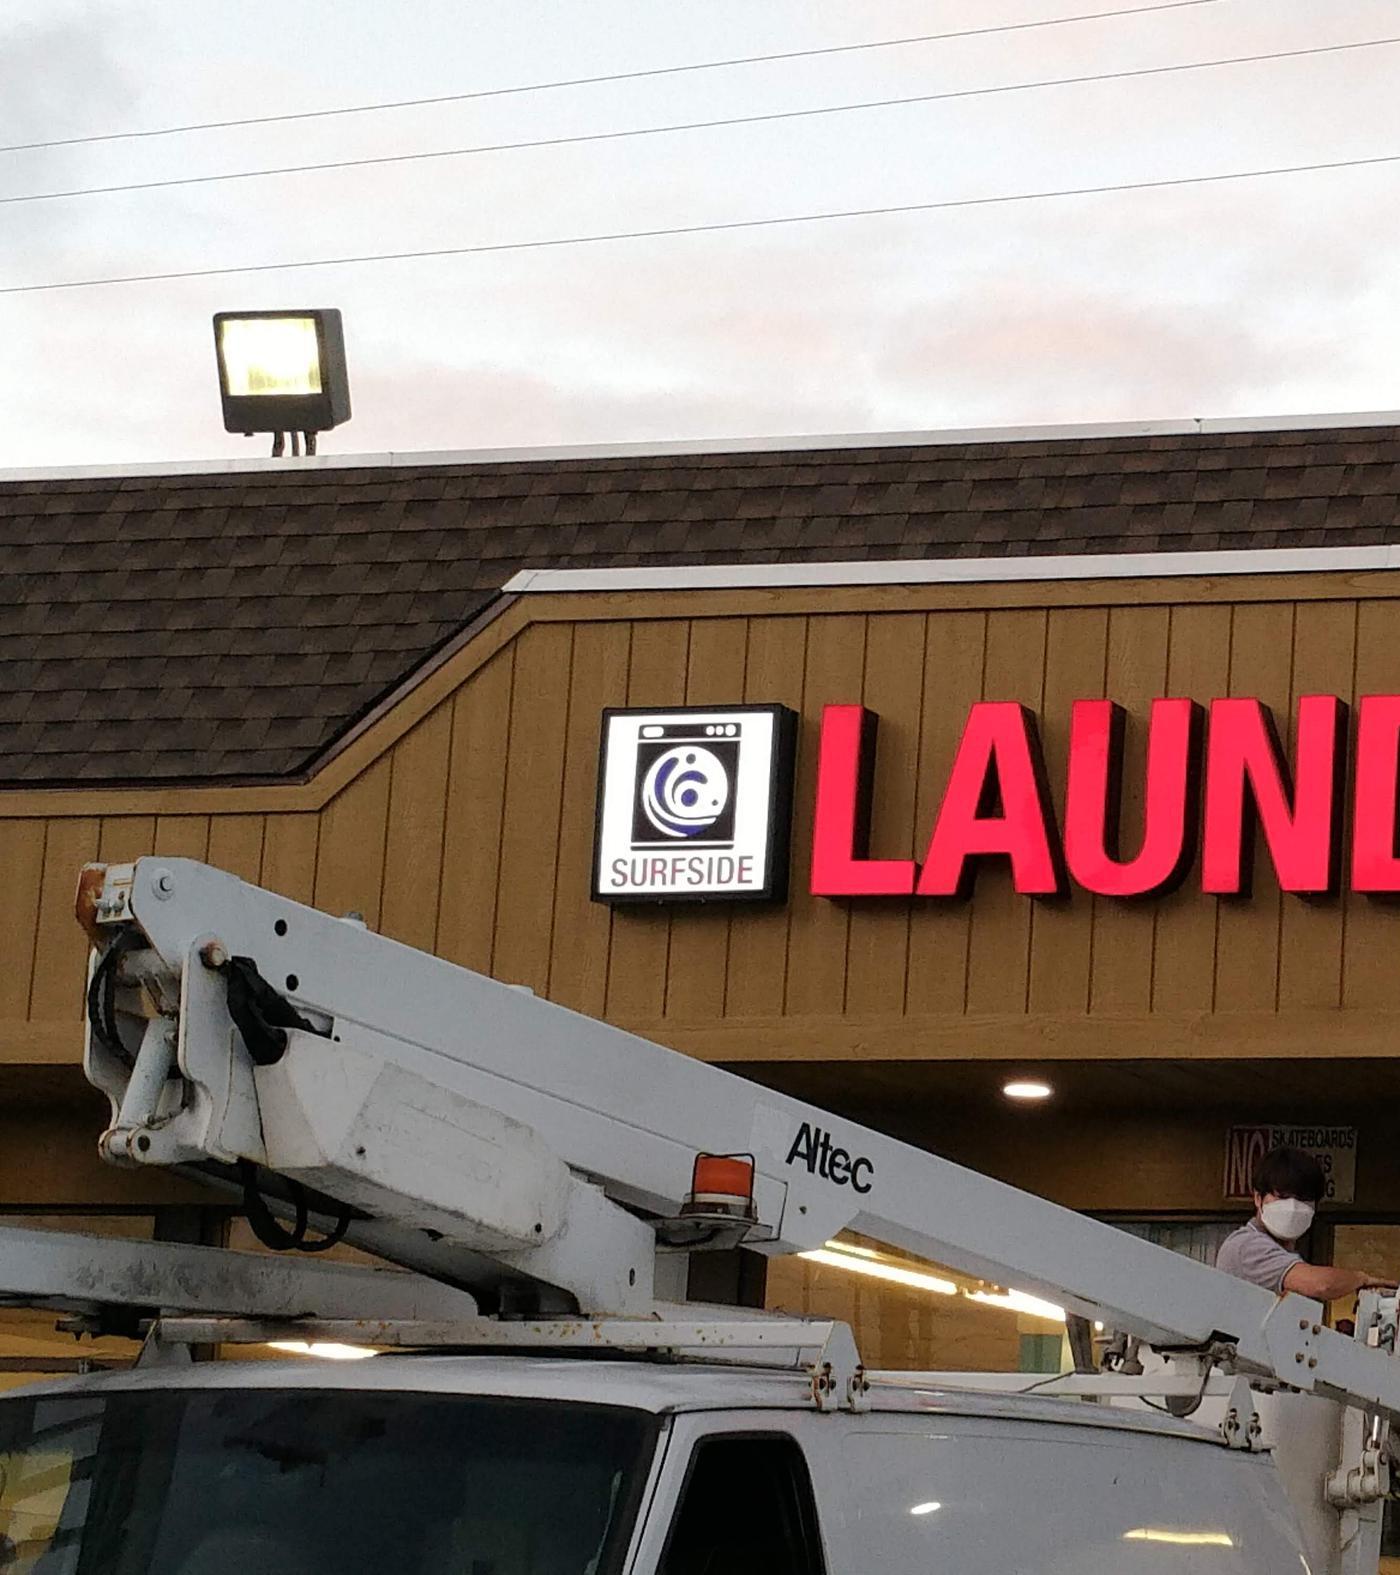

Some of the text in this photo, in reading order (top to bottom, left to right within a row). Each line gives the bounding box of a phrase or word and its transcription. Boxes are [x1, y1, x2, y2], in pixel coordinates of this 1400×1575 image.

[611, 856, 754, 887] SURFSIDE
[1271, 1129, 1355, 1148] SKATEBOARDS
[785, 1122, 874, 1194] Altec
